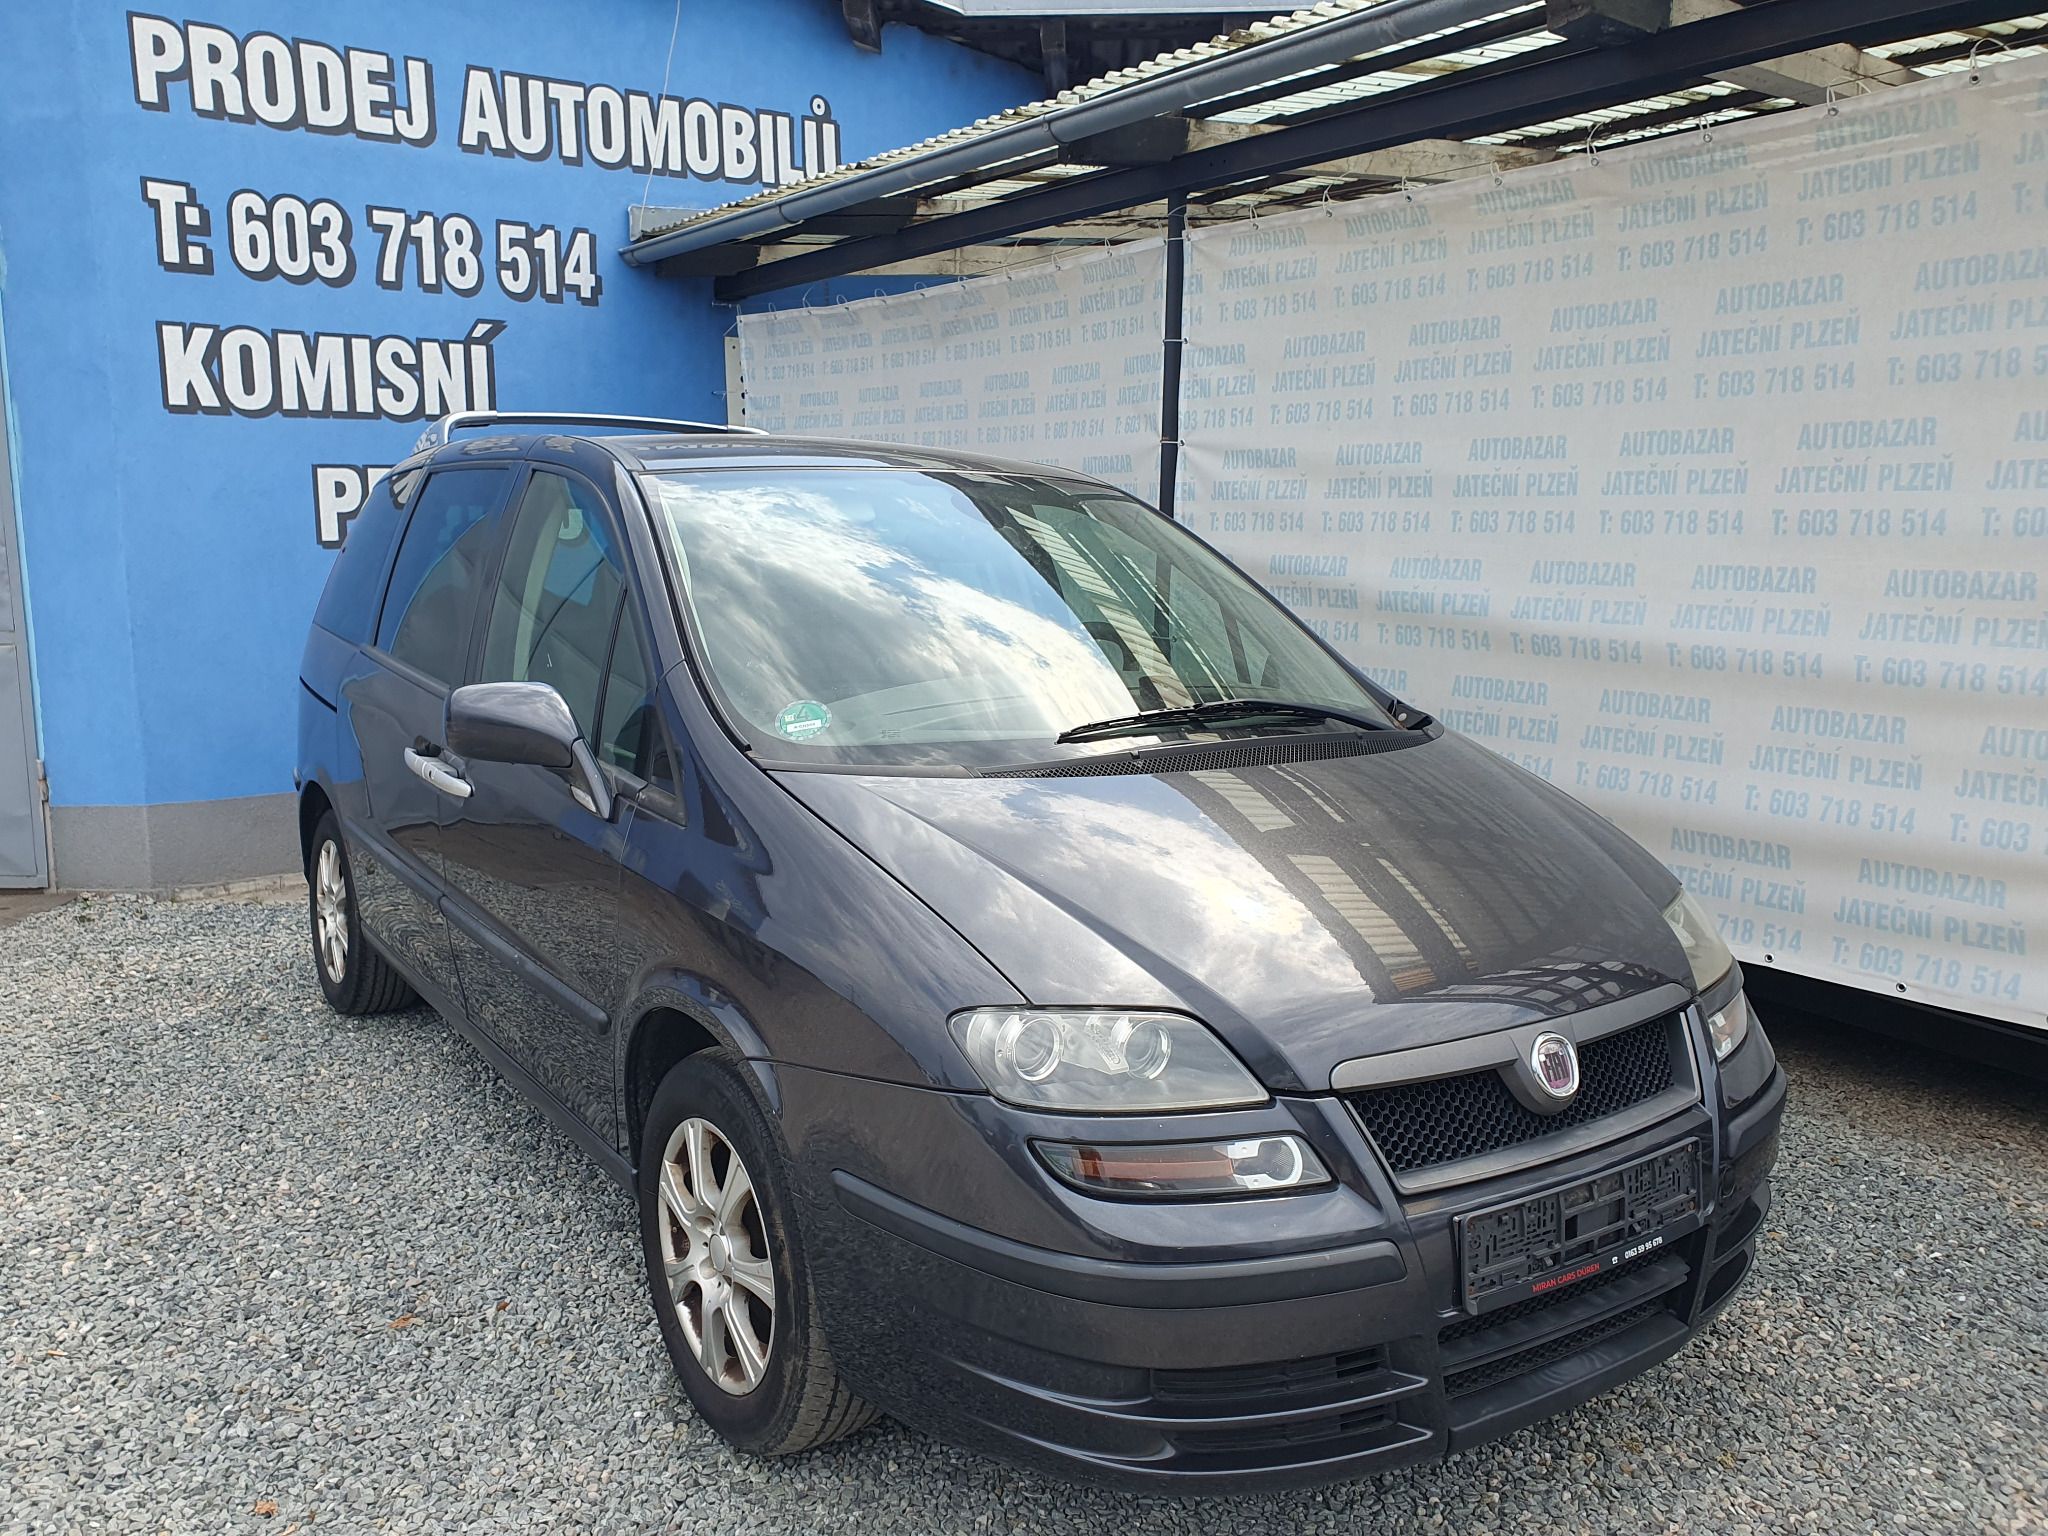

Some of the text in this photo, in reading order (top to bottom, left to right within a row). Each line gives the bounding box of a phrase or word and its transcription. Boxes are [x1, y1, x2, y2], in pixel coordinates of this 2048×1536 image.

[129, 13, 839, 187] PRODEJ AUTOMOBILŮ
[1478, 178, 1576, 216] AUTOBAZAR
[143, 178, 599, 302] T: 603 718 514
[1347, 207, 1431, 239] AUTOBAZAR
[1466, 206, 1592, 254] JATEČNÍ PLZEŇ
[1334, 230, 1445, 273] JATEČNÍ PLZEŇ
[1466, 252, 1593, 292] T: 603 718 514
[1333, 272, 1446, 308] T: 603 718 514
[1714, 273, 1843, 314] AUTOBAZAR
[1408, 315, 1500, 346] AUTOBAZAR
[1549, 297, 1656, 331] AUTOBAZAR
[1283, 330, 1365, 358] AUTOBAZAR
[1533, 327, 1670, 371] JATEČNÍ PLZEŇ
[1695, 306, 1860, 358] JATEČNÍ PLZEŇ
[159, 321, 498, 417] KOMISNÍ
[1271, 356, 1375, 392] JATEČNÍ PLZEŇ
[1394, 343, 1512, 382] JATEČNÍ PLZEŇ
[1532, 377, 1667, 408] T: 603 718 514
[1693, 362, 1855, 399] T: 603 718 514
[1270, 398, 1373, 424] T: 603 718 514
[1393, 388, 1509, 416] T: 603 718 514
[1468, 436, 1566, 461] AUTOBAZAR
[1618, 428, 1733, 456] AUTOBAZAR
[1797, 417, 1936, 450] AUTOBAZAR
[1222, 447, 1296, 469] AUTOBAZAR
[1336, 442, 1421, 465] AUTOBAZAR
[1210, 472, 1305, 500] JATEČNÍ PLZEŇ
[1323, 469, 1432, 498] JATEČNÍ PLZEŇ
[1452, 465, 1578, 496] JATEČNÍ PLZEŇ
[1601, 460, 1747, 495] JATEČNÍ PLZEŇ
[1775, 452, 1954, 493] JATEČNÍ PLZEŇ
[1210, 512, 1303, 530] T: 603 718 514
[1322, 511, 1430, 531] T: 603 718 514
[1450, 510, 1575, 532] T: 603 718 514
[1599, 510, 1743, 534] T: 603 718 514
[1772, 509, 1946, 536] T: 603 718 514
[1390, 556, 1479, 581] AUTOBAZAR
[1690, 565, 1816, 593] AUTOBAZAR
[1883, 569, 2036, 601] AUTOBAZAR
[1377, 585, 1491, 617] JATEČNÍ PLZEŇ
[1670, 598, 1830, 636] JATEČNÍ PLZEŇ
[1377, 624, 1488, 651] T: 603 718 514
[1858, 606, 1964, 643] JATEČNÍ
[1667, 643, 1823, 677] T: 603 718 514
[1854, 655, 2047, 696] T: 603 718 514
[1598, 688, 1710, 723] AUTOBAZAR
[1770, 705, 1905, 744] AUTOBAZAR
[1579, 722, 1723, 765] JATEČNÍ PLZEŇ
[1576, 762, 1717, 804] T: 603 718 514
[1748, 742, 1922, 791] JATEČNÍ PLZEŇ
[1745, 785, 1915, 835] T: 603 718 514
[1857, 859, 2005, 908] AUTOBAZAR
[1834, 897, 2025, 957] JATEČNÍ PLZEŇ
[1831, 936, 2021, 1000] T: 603 718 514
[1532, 1263, 1600, 1293] MIRAN CARS DÜREN
